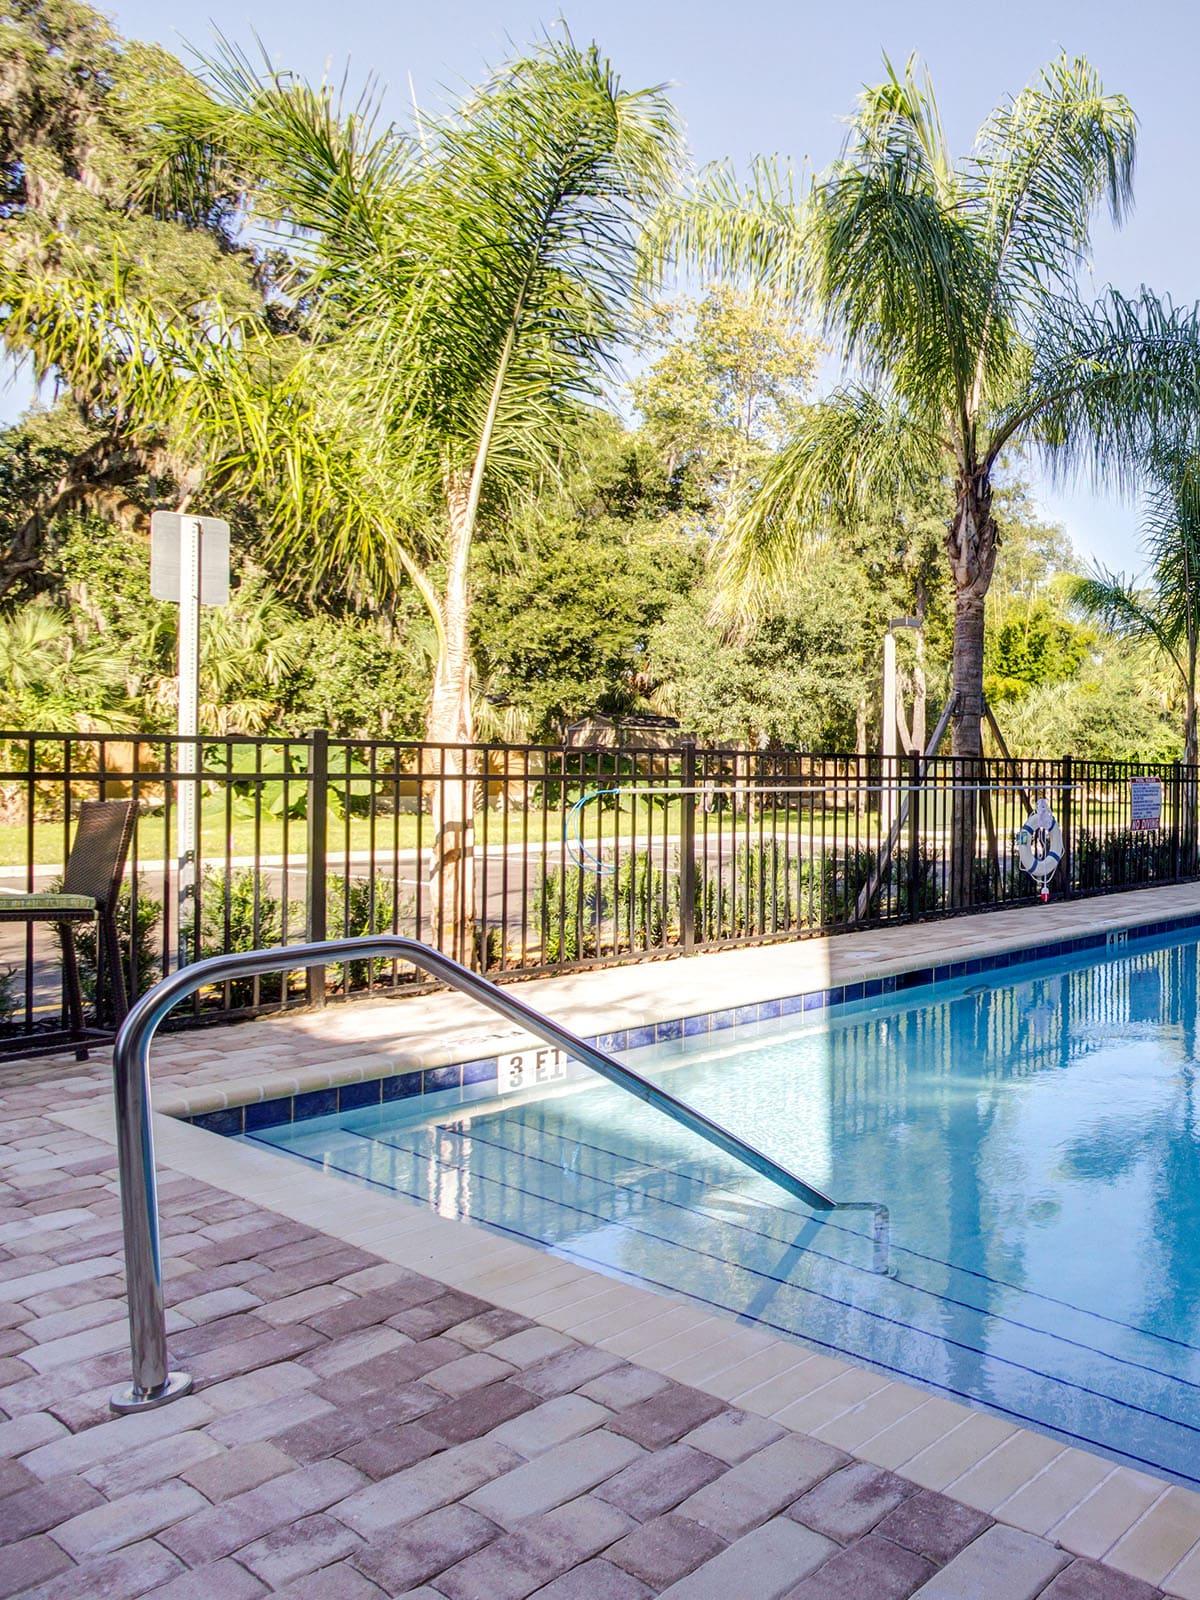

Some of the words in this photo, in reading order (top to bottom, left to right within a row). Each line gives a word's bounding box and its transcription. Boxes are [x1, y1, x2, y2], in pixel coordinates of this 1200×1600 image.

[1132, 819, 1141, 830] NO
[1141, 818, 1159, 829] DIVING
[510, 1056, 523, 1075] 3
[536, 1048, 561, 1069] FT
